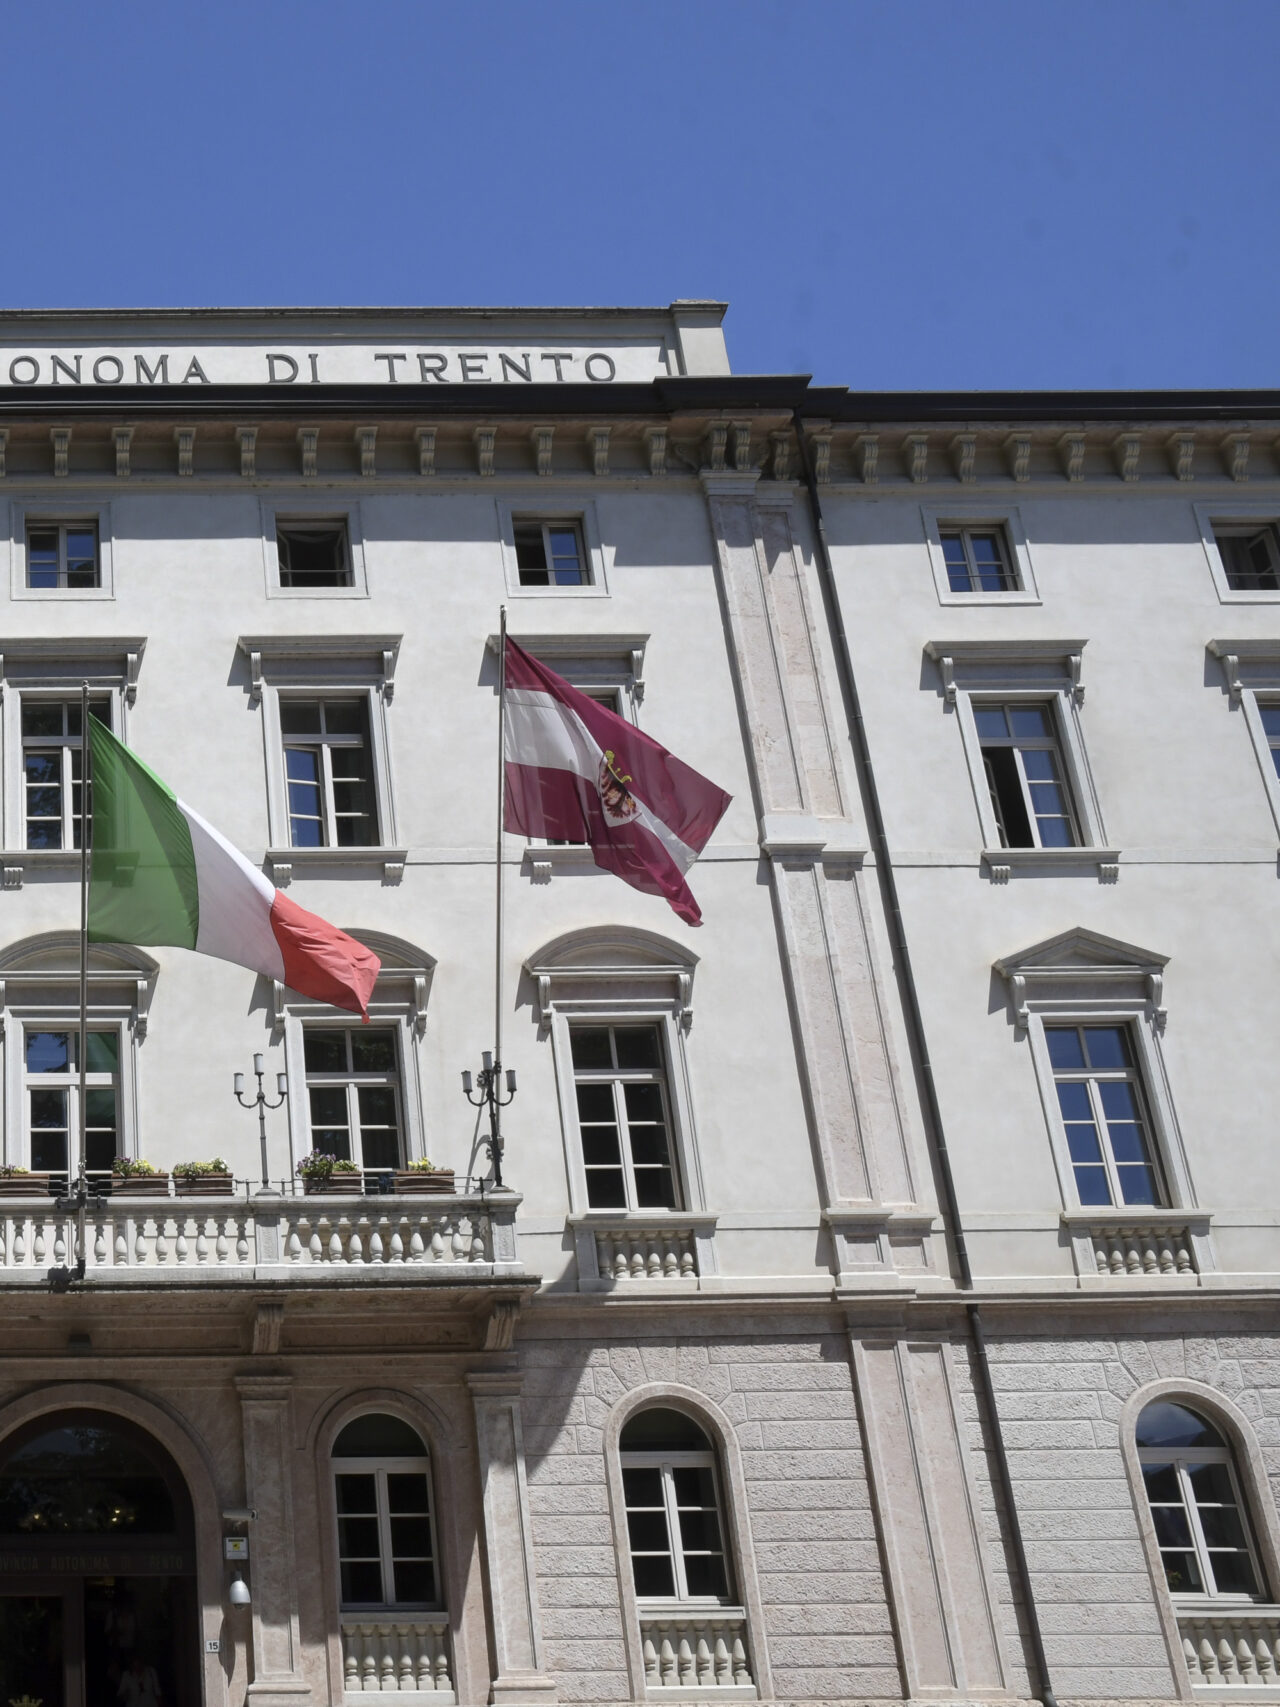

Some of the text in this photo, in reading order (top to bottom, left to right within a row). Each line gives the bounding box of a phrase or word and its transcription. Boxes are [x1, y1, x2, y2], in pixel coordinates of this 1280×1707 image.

[266, 353, 322, 384] DI
[374, 352, 617, 384] TRENTO
[209, 1642, 219, 1650] 15
